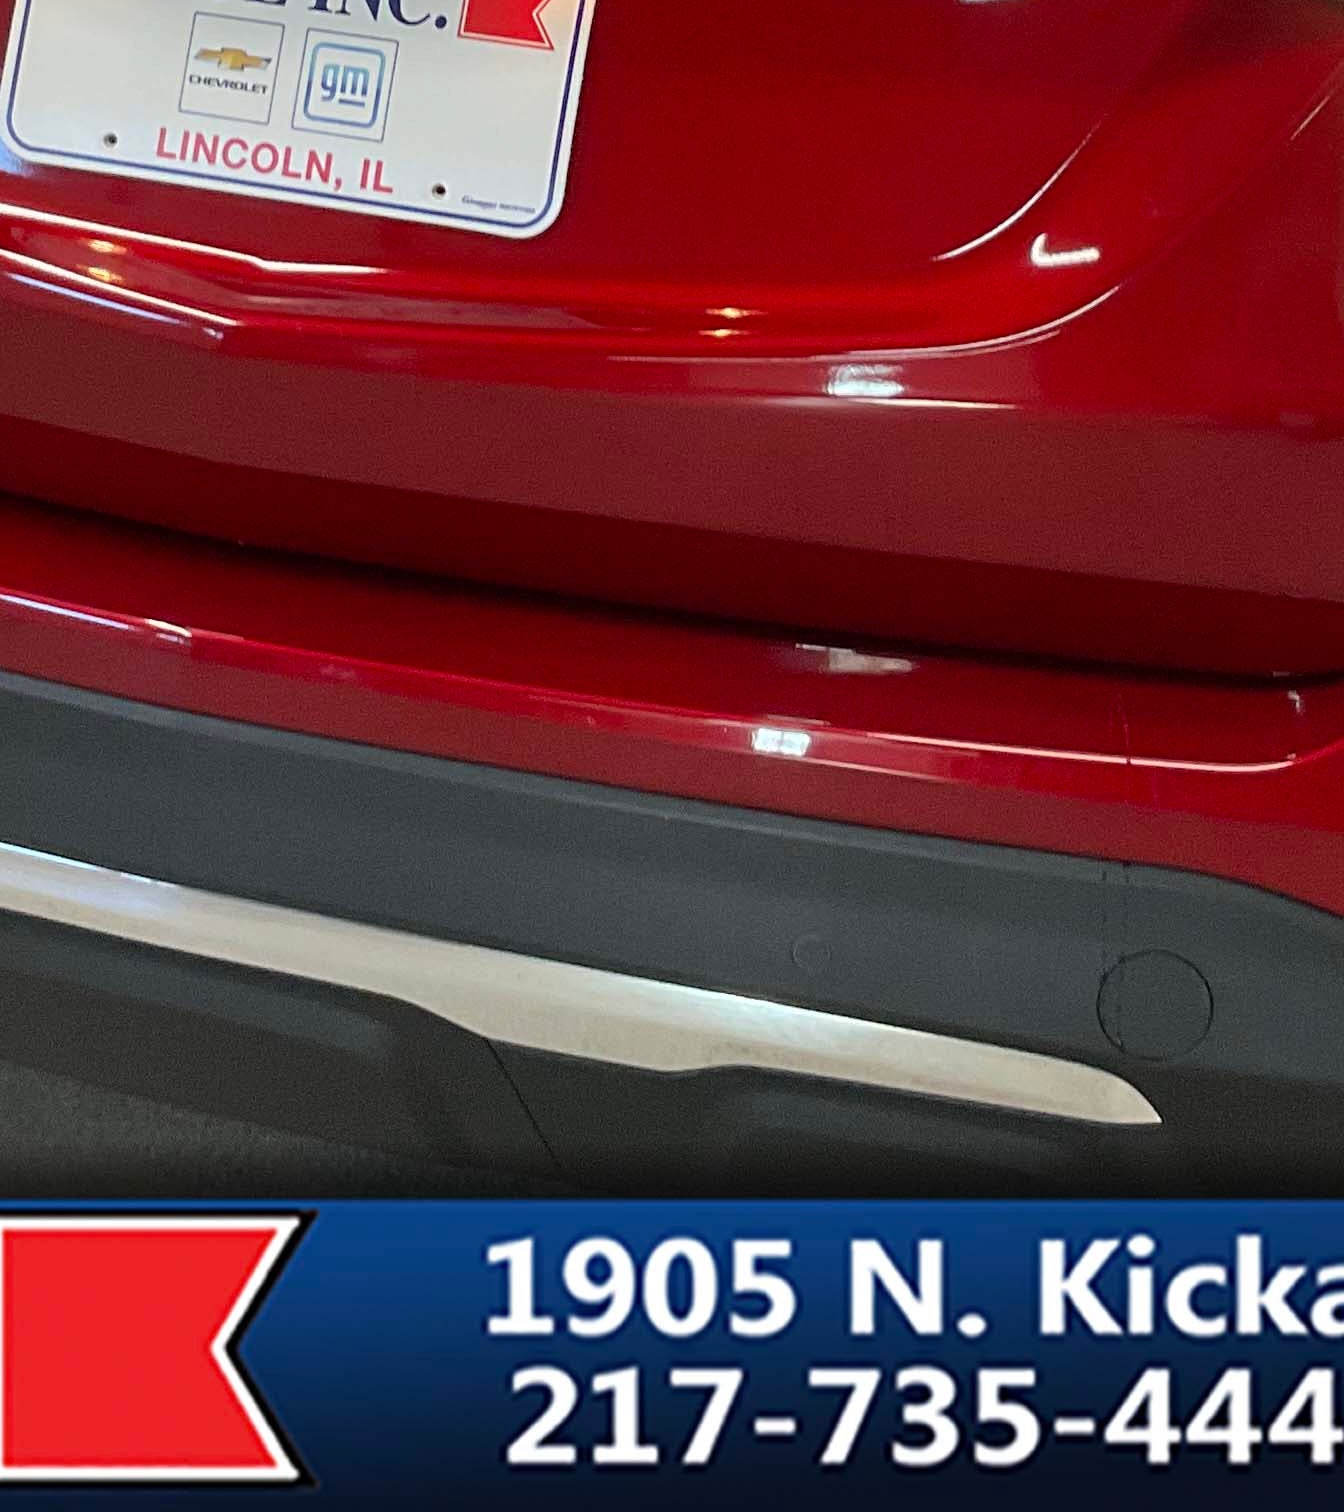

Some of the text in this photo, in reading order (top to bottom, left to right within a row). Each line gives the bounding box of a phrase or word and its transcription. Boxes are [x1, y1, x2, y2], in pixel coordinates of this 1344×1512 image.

[188, 73, 268, 96] CHEVROLET
[321, 63, 370, 102] gm
[156, 127, 394, 194] LINCOLN, IL
